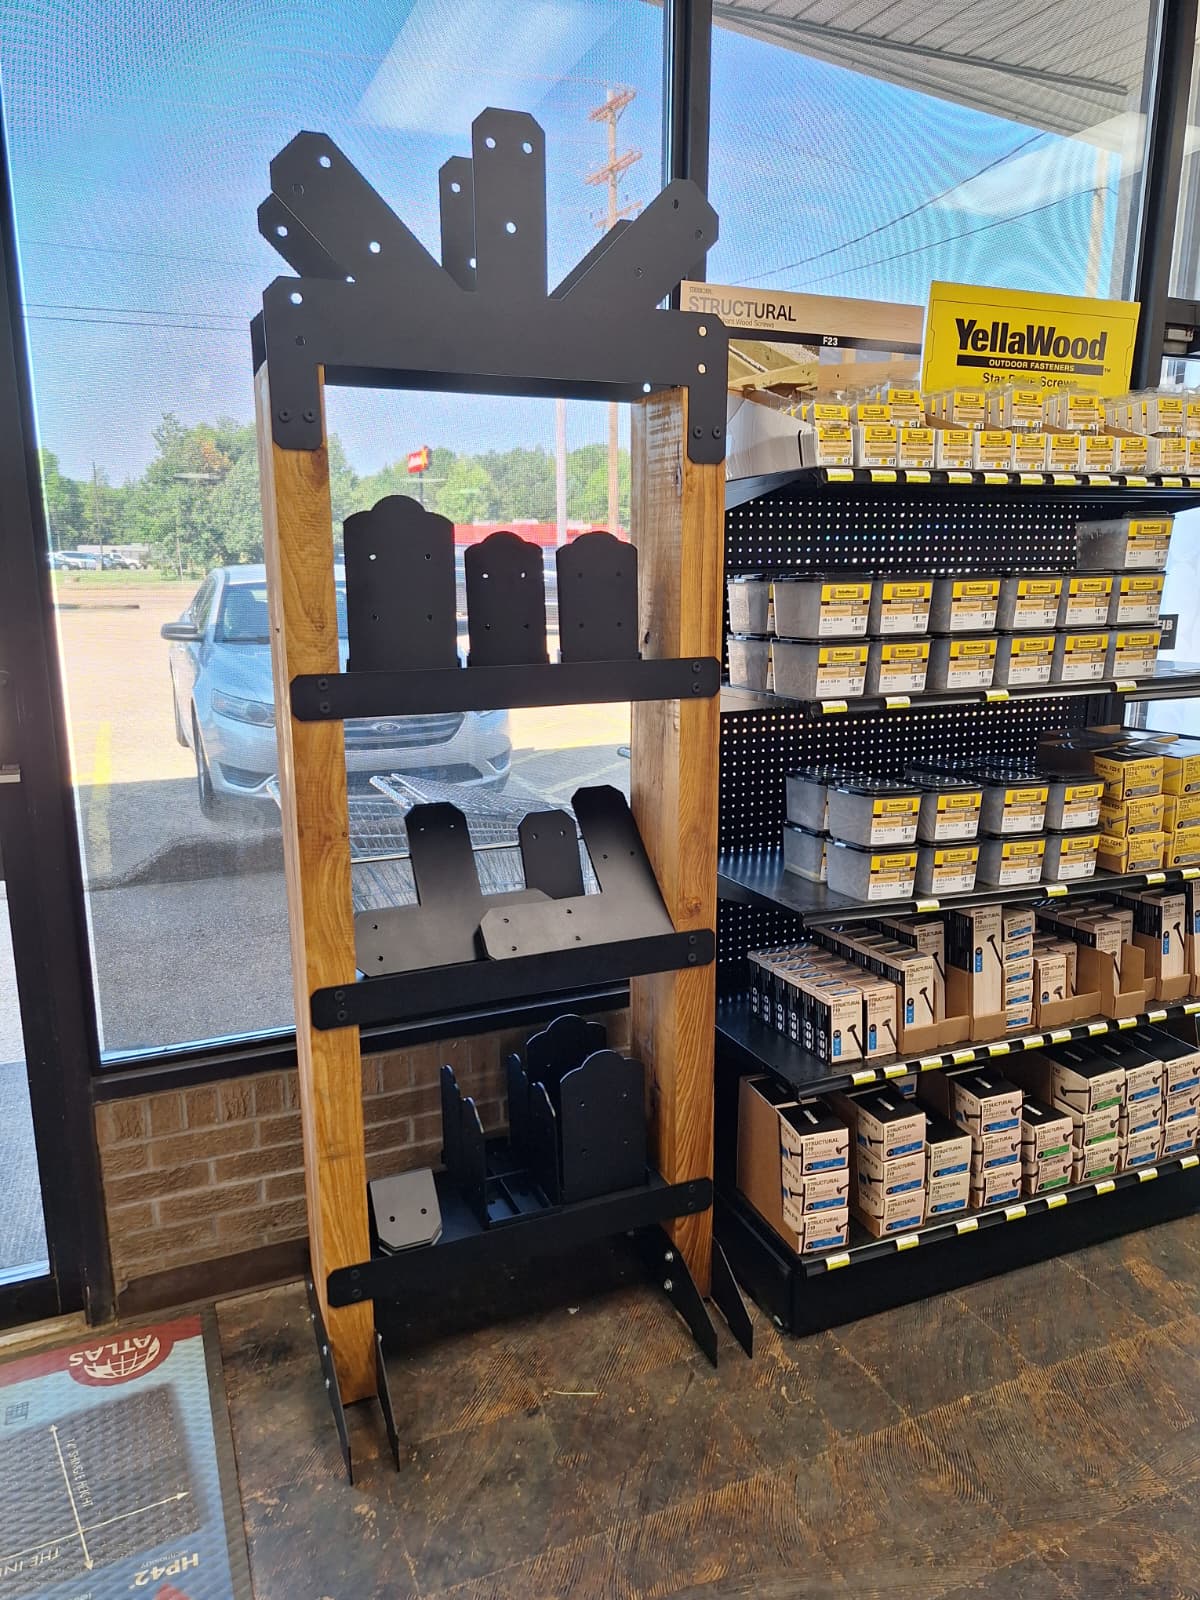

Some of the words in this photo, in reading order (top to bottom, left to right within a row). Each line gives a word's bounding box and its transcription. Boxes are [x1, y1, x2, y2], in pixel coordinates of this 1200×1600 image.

[689, 296, 797, 322] STRUCTURAL
[822, 336, 839, 346] F23
[955, 318, 1108, 361] YellaWood
[988, 359, 1029, 369] OUTDOOR
[1030, 361, 1075, 372] FASTENERS
[69, 1334, 153, 1367] ATLAS
[74, 1480, 94, 1508] HEIGHT
[0, 1559, 24, 1578] IN
[30, 1546, 61, 1568] THE
[134, 1552, 200, 1587] HP42
